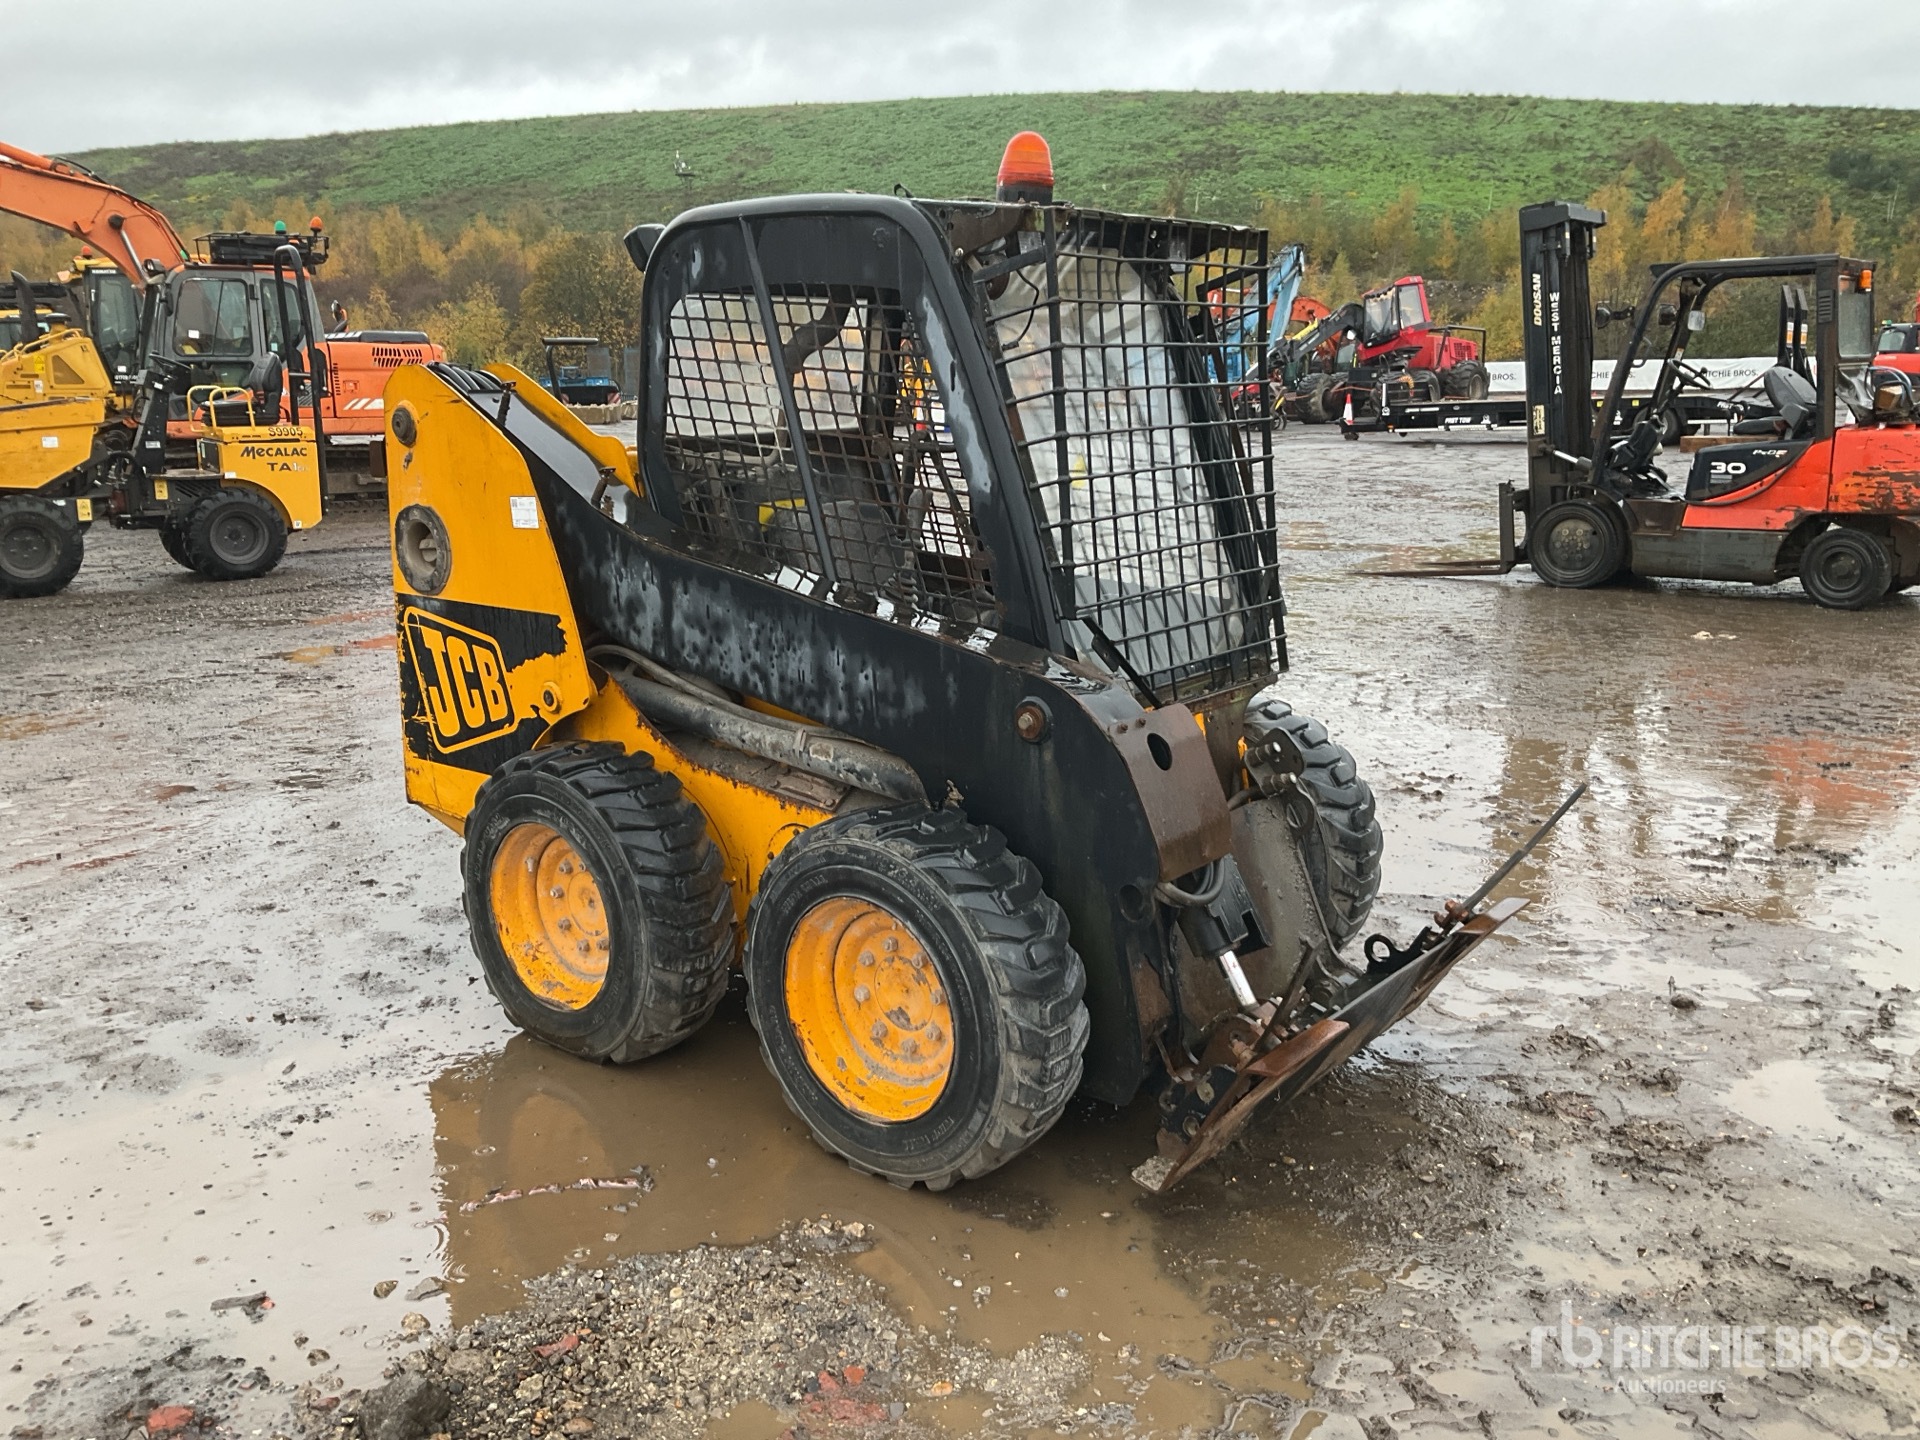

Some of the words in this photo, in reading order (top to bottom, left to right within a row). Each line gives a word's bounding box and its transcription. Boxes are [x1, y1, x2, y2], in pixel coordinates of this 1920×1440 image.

[1532, 273, 1542, 326] DOOSAN
[1549, 292, 1560, 332] WEST
[1551, 335, 1562, 395] MERCIA
[1591, 371, 1610, 379] CHIE
[1704, 369, 1731, 378] ITCHIE
[1733, 369, 1759, 377] BROS.
[267, 427, 303, 437] S9905
[1710, 461, 1747, 475] 30
[420, 625, 508, 738] JCB
